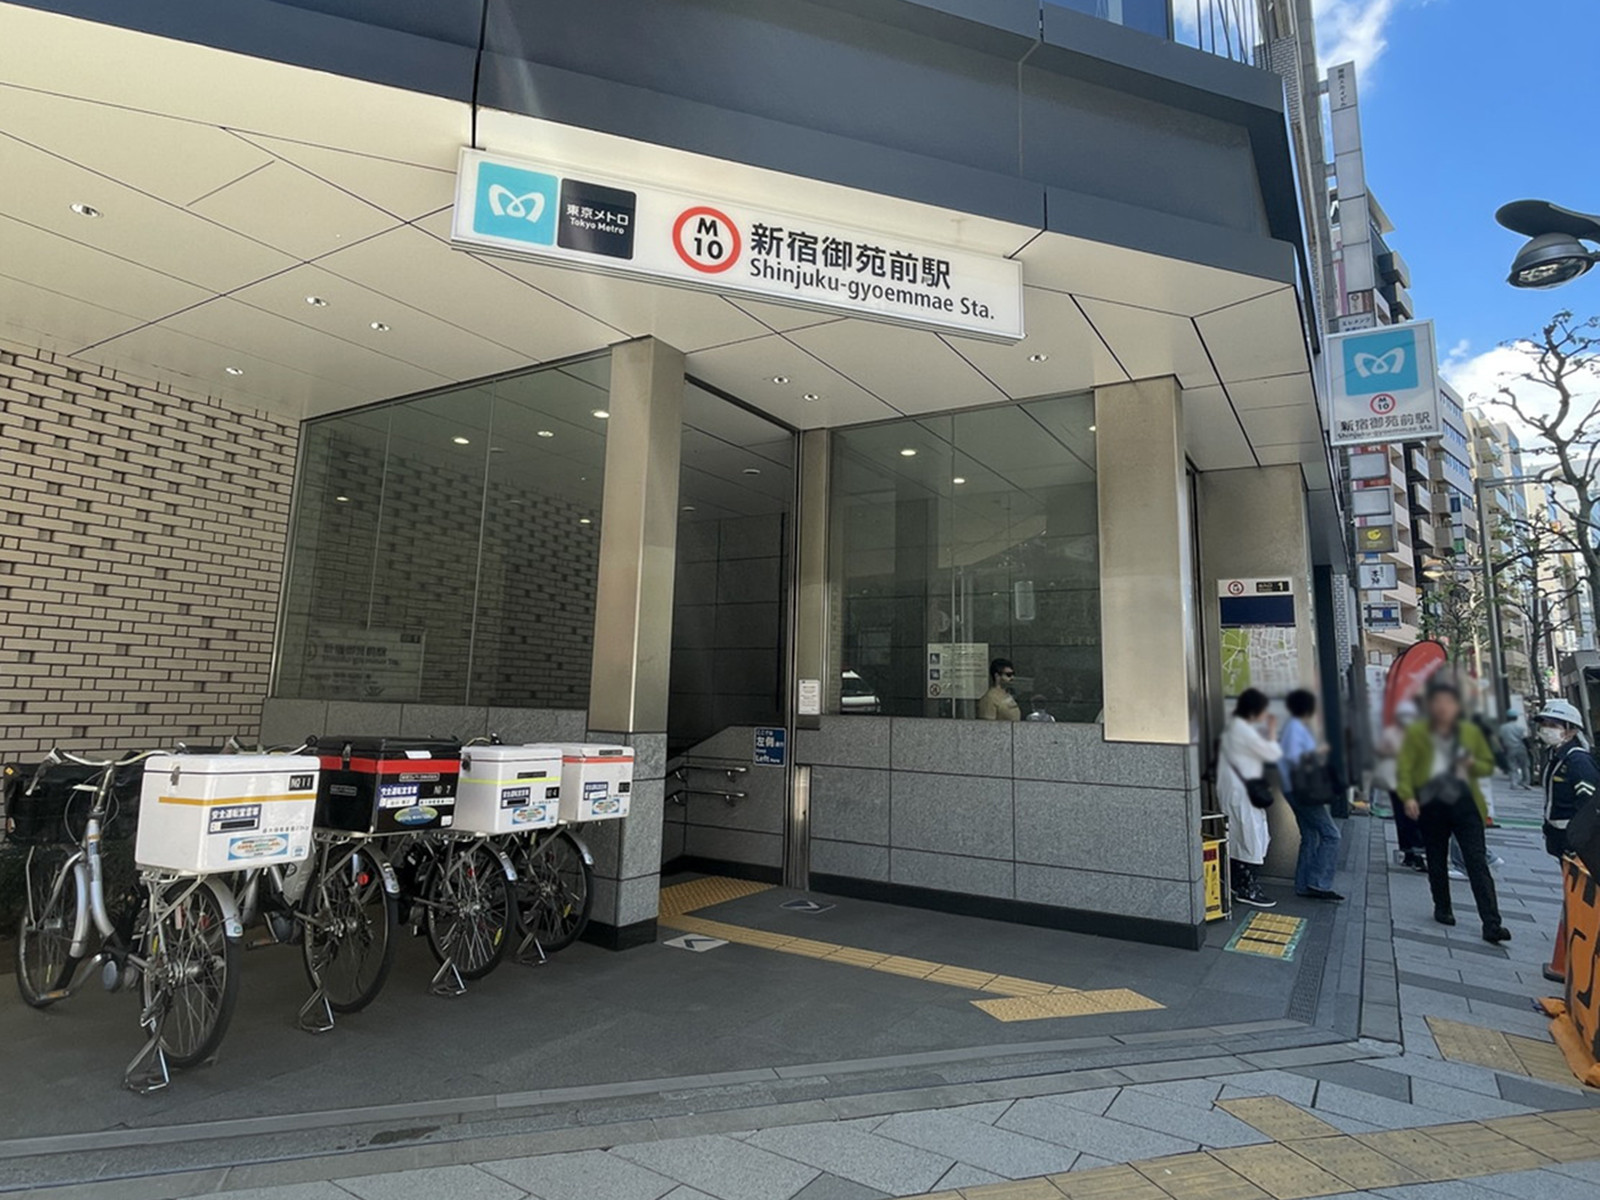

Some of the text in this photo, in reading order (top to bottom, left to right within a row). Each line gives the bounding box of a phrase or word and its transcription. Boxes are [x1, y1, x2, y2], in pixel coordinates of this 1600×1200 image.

[566, 203, 629, 227] 東京メトロ
[570, 217, 625, 235] Tokyo Metro
[697, 217, 719, 237] M
[693, 237, 724, 260] 10
[751, 222, 951, 290] 新宿御苑前駅
[750, 258, 994, 320] Shinjuku-gyoemmae Sta.
[1341, 411, 1431, 432] 新宿御苑前駅
[1279, 582, 1284, 591] 1
